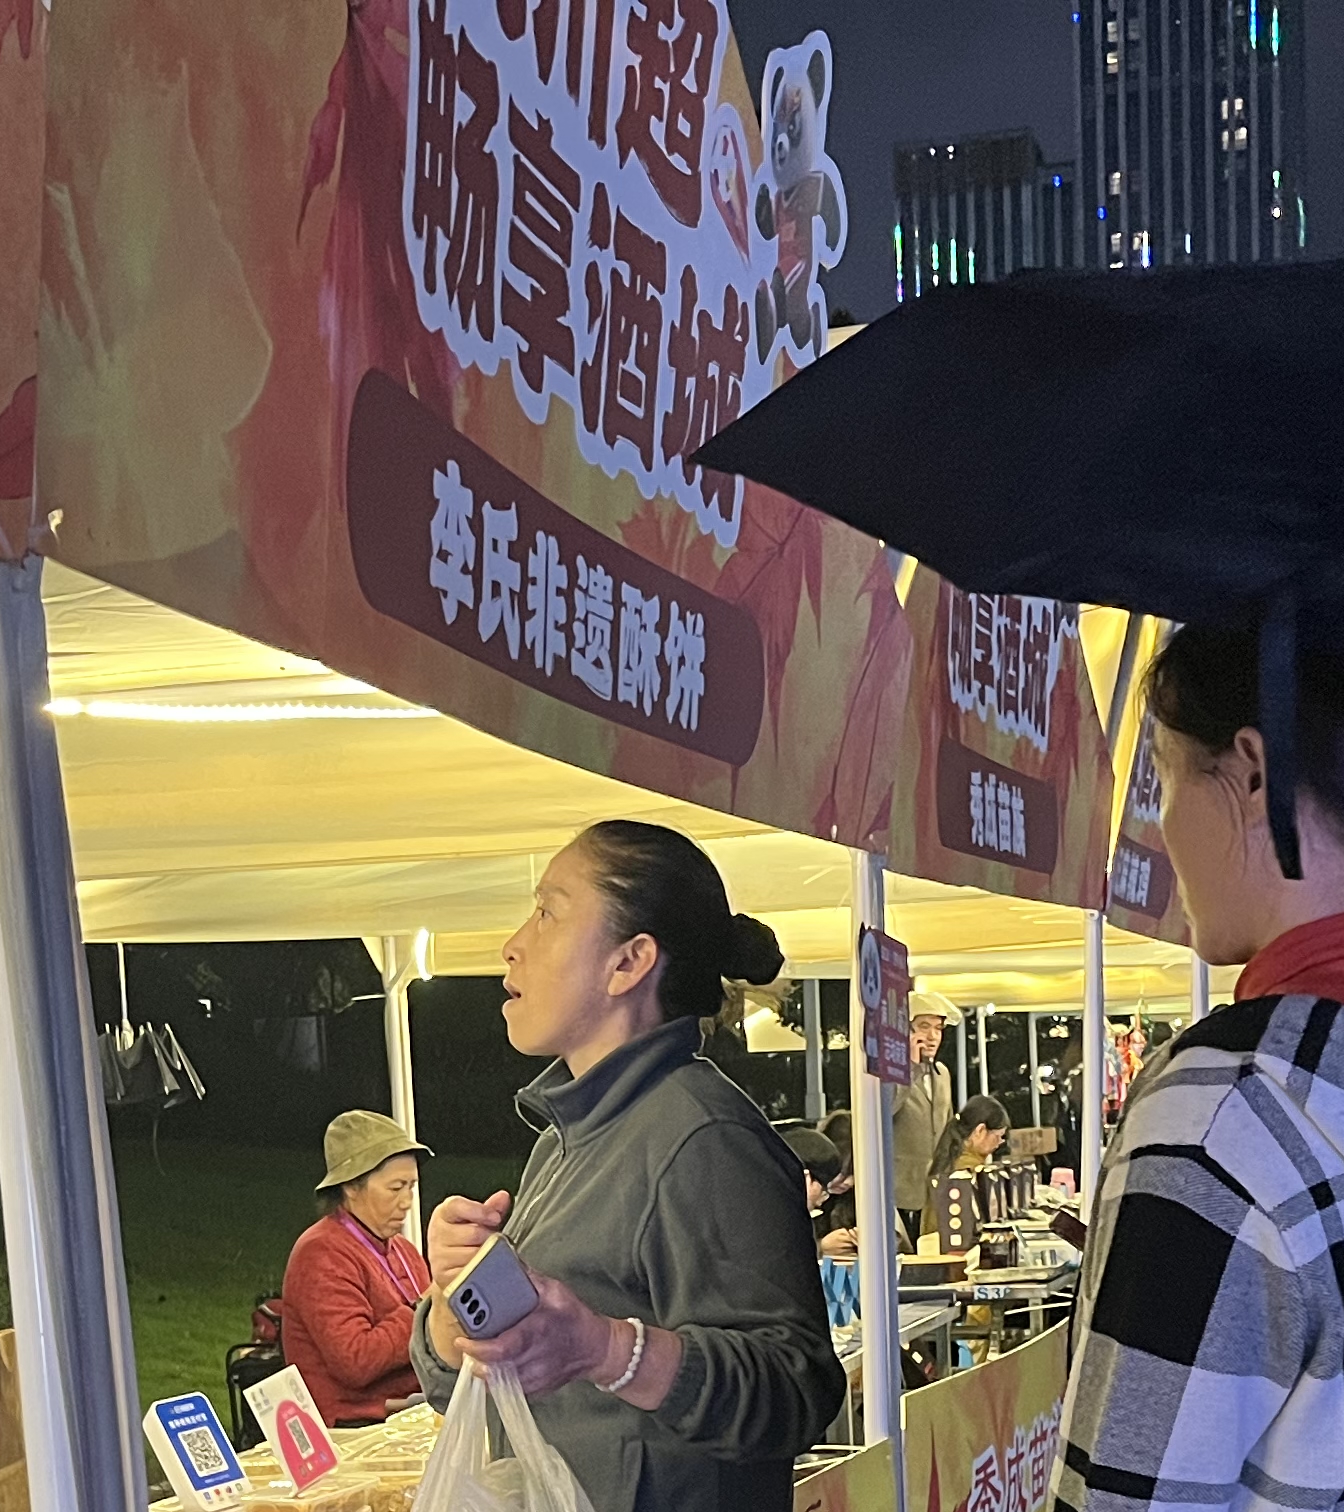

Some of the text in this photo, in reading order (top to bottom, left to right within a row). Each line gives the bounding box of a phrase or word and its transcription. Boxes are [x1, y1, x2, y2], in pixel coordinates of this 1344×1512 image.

[429, 461, 706, 731] 李氏非遗酥饼
